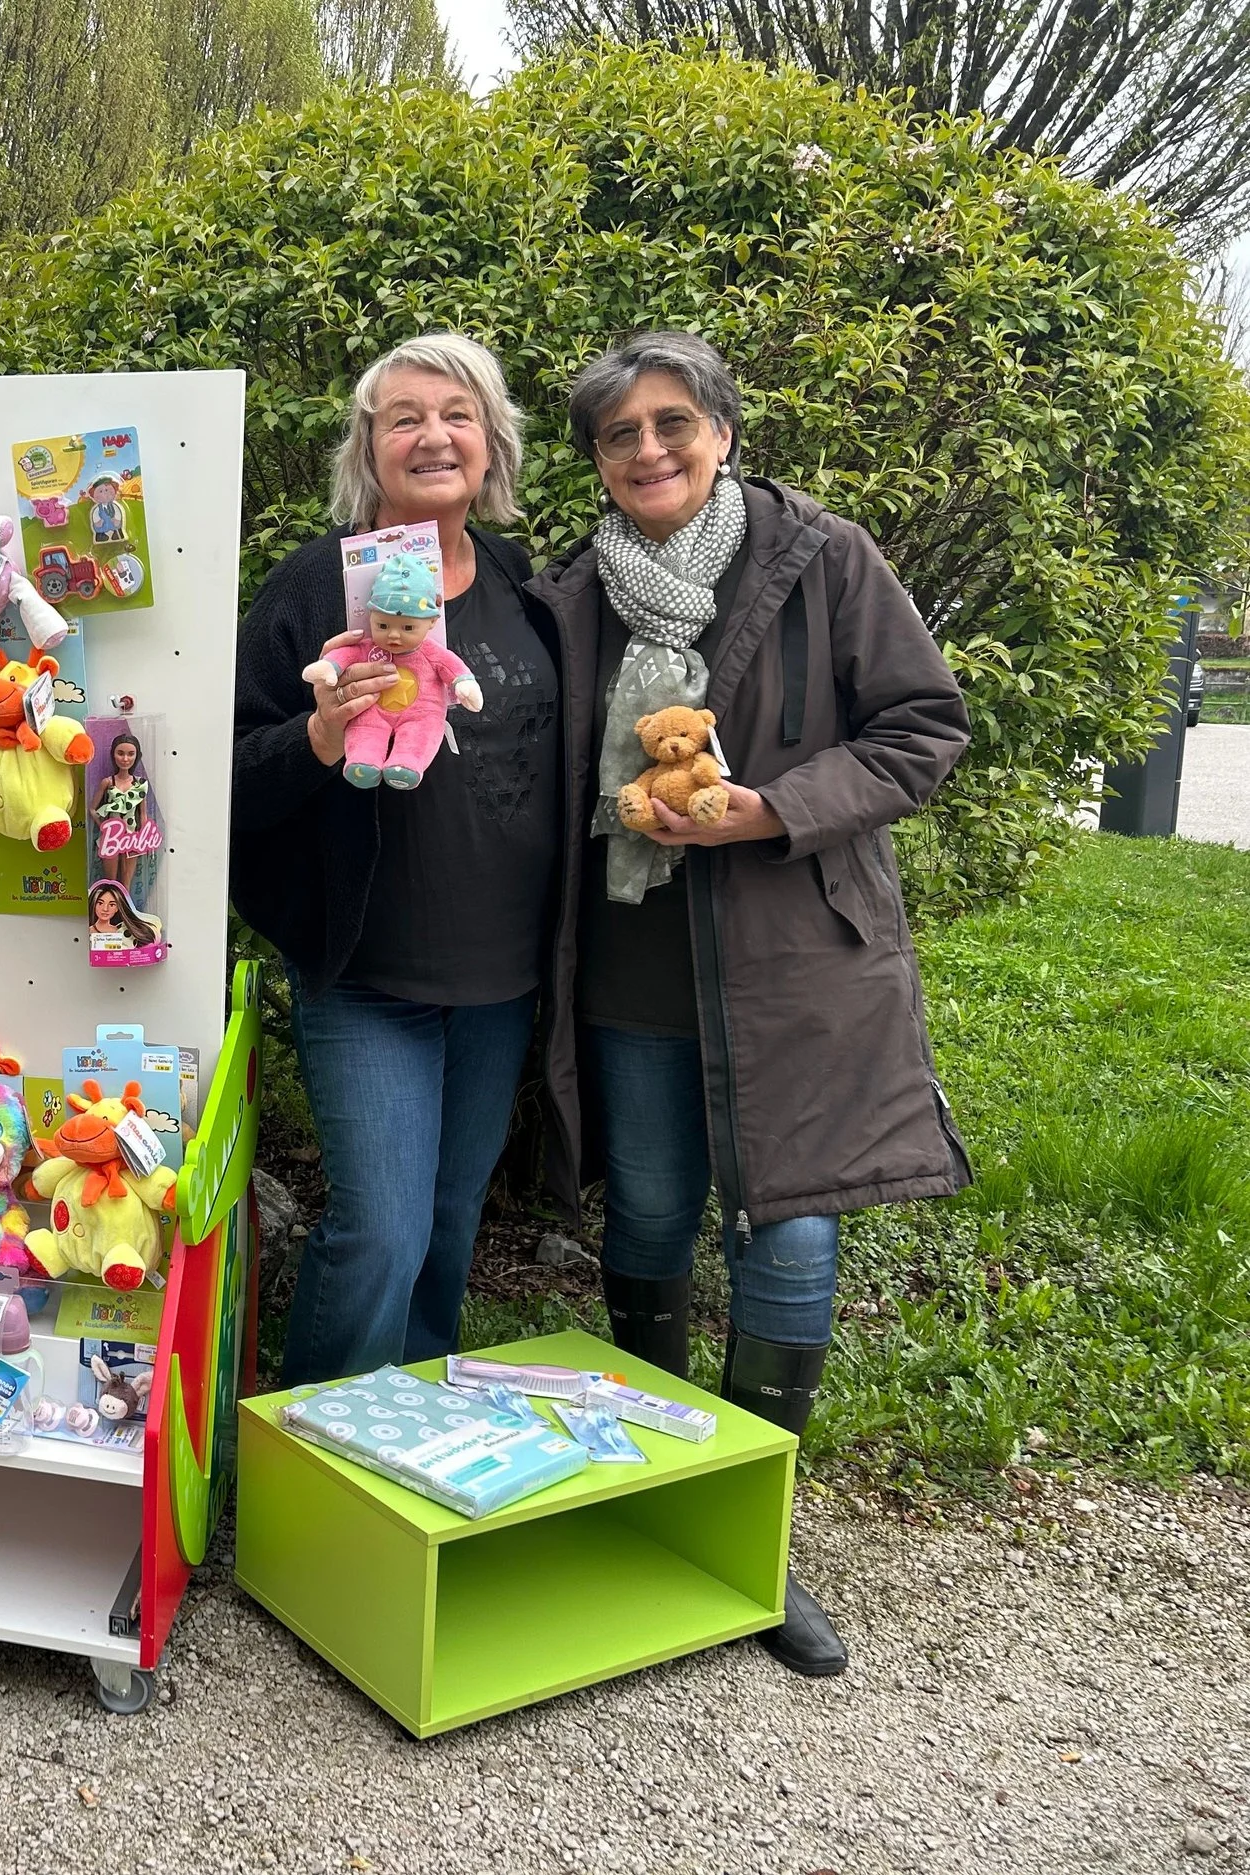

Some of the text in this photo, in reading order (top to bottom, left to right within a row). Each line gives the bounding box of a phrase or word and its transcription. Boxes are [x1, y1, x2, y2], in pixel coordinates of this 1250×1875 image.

[102, 434, 132, 448] HABA
[402, 537, 434, 552] BABY
[371, 649, 384, 661] Try
[100, 821, 163, 857] Barbie
[418, 1438, 481, 1469] Bettwäsche
[477, 1431, 500, 1441] Set
